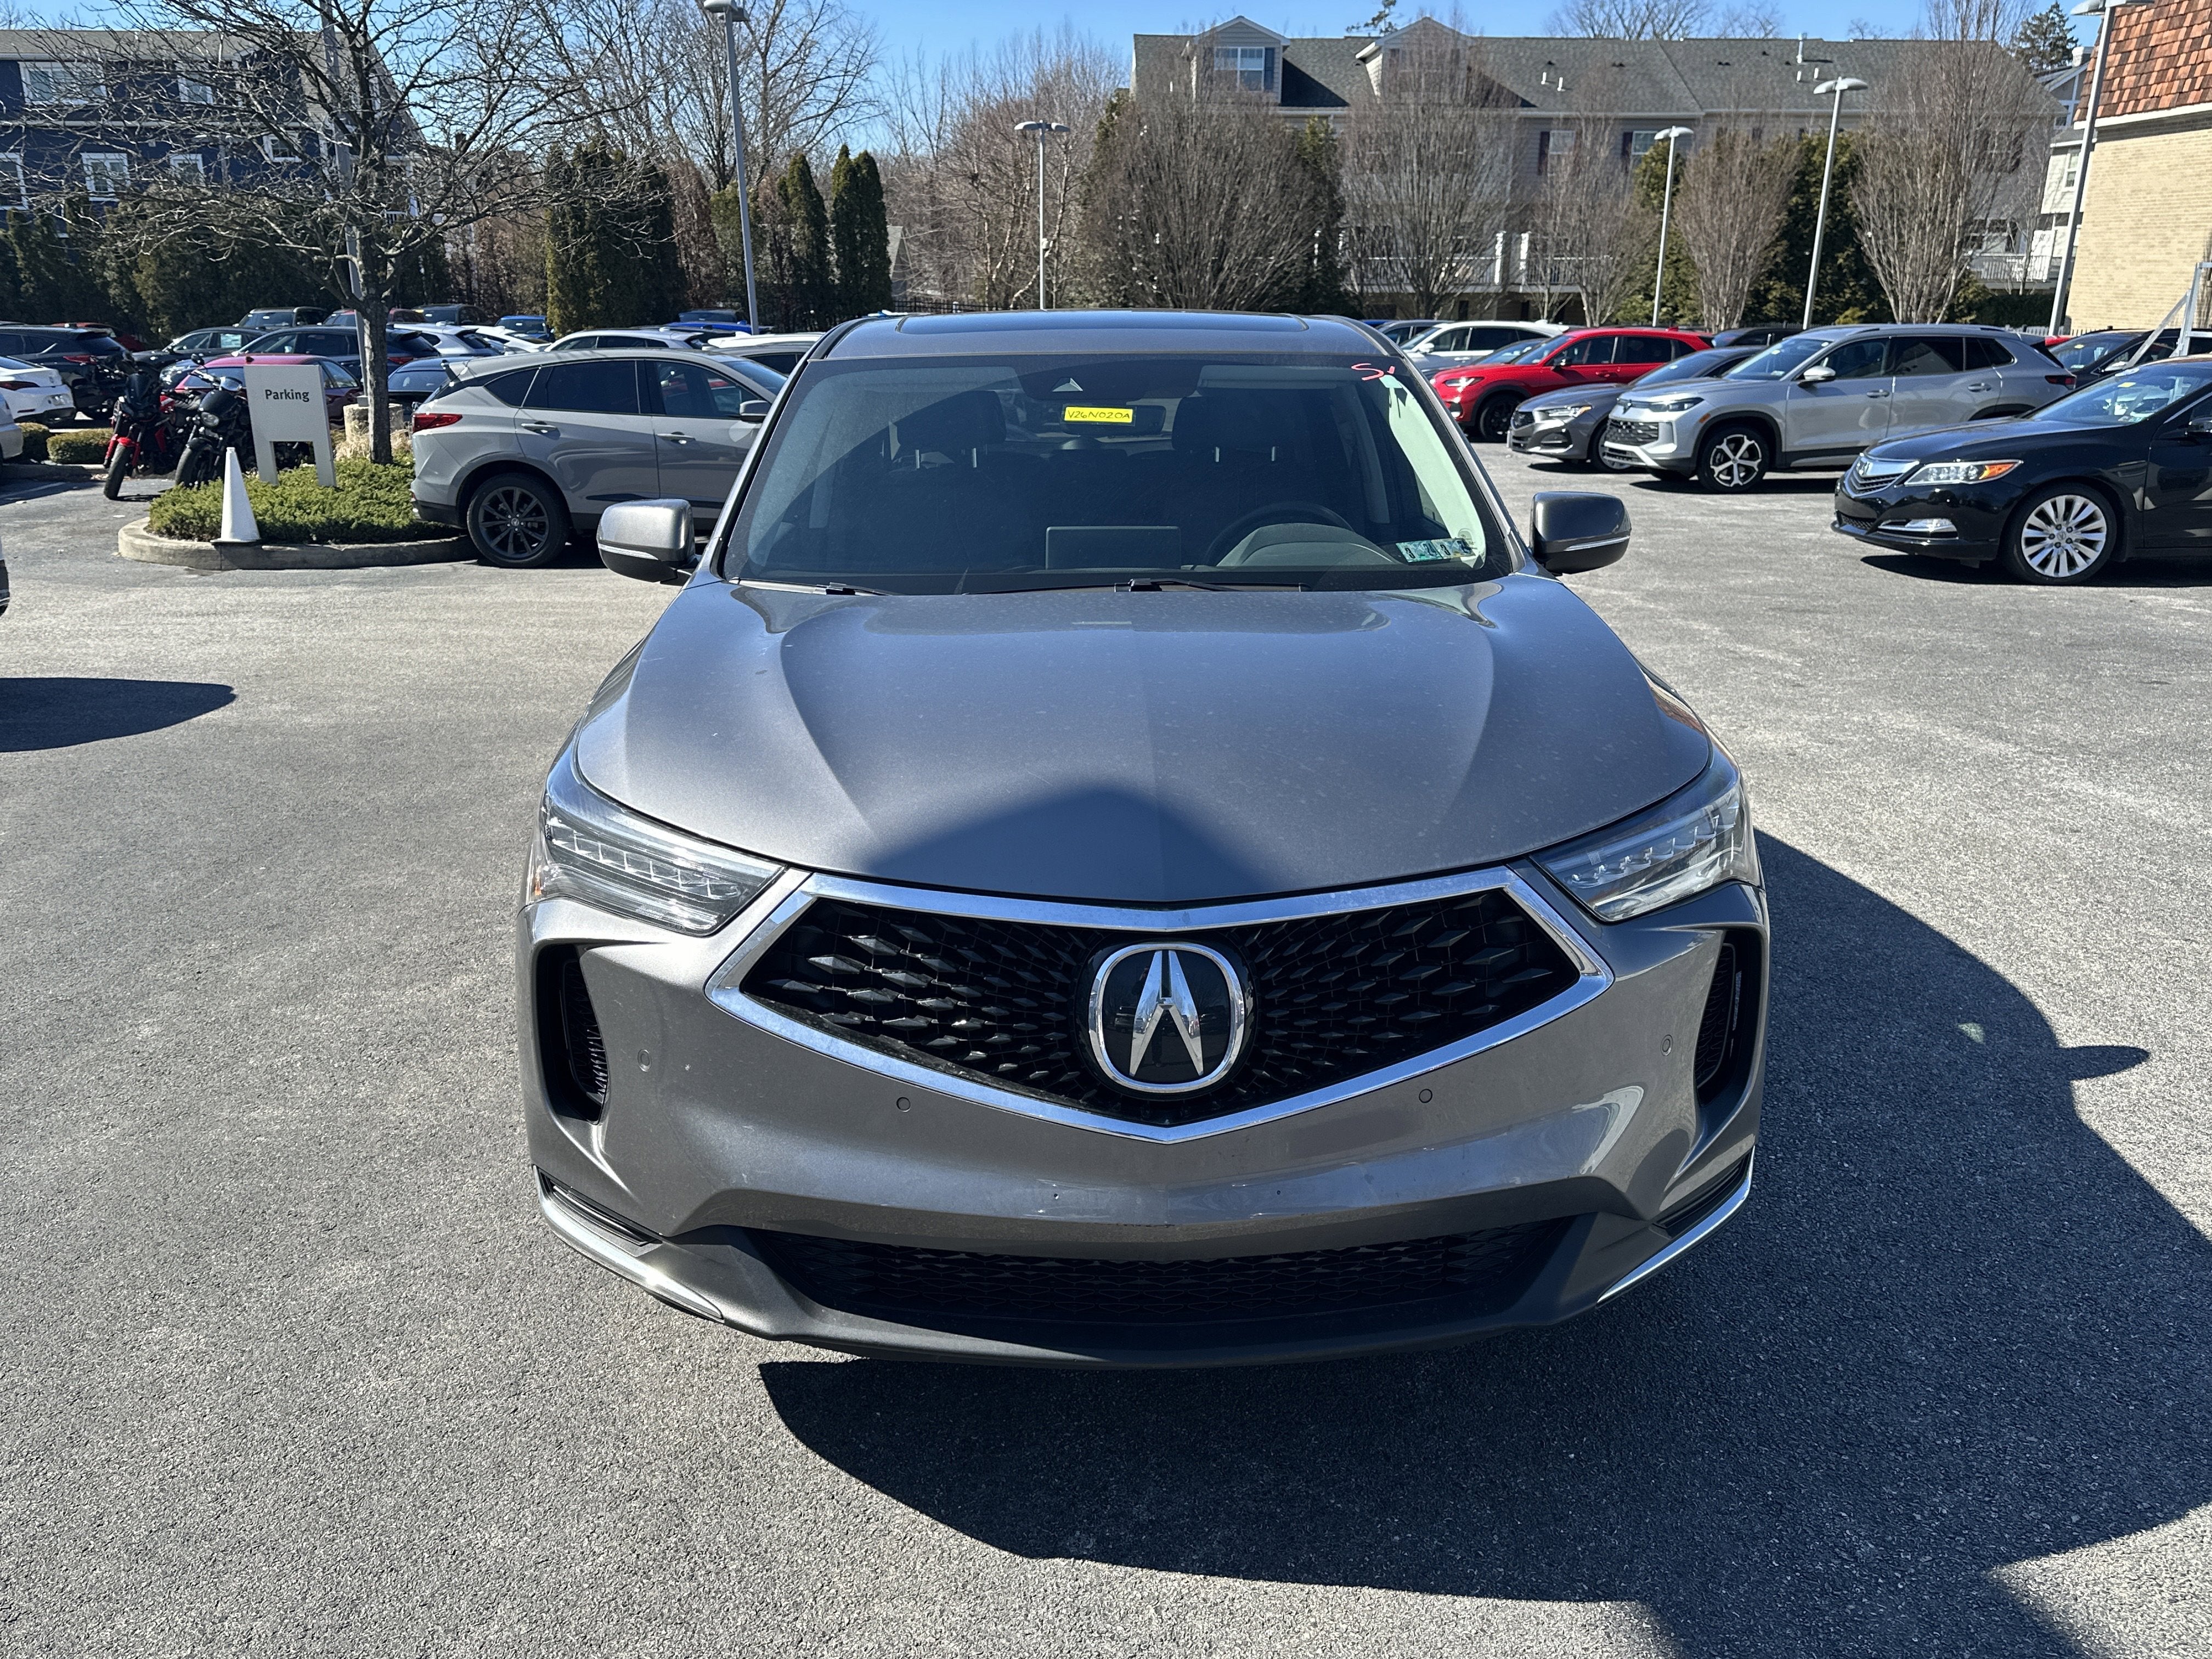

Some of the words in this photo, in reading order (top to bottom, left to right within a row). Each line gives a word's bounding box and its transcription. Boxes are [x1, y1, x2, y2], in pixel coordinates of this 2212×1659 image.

[265, 389, 309, 402] Parking
[1404, 548, 1415, 558] 3
[1440, 544, 1451, 555] 3
